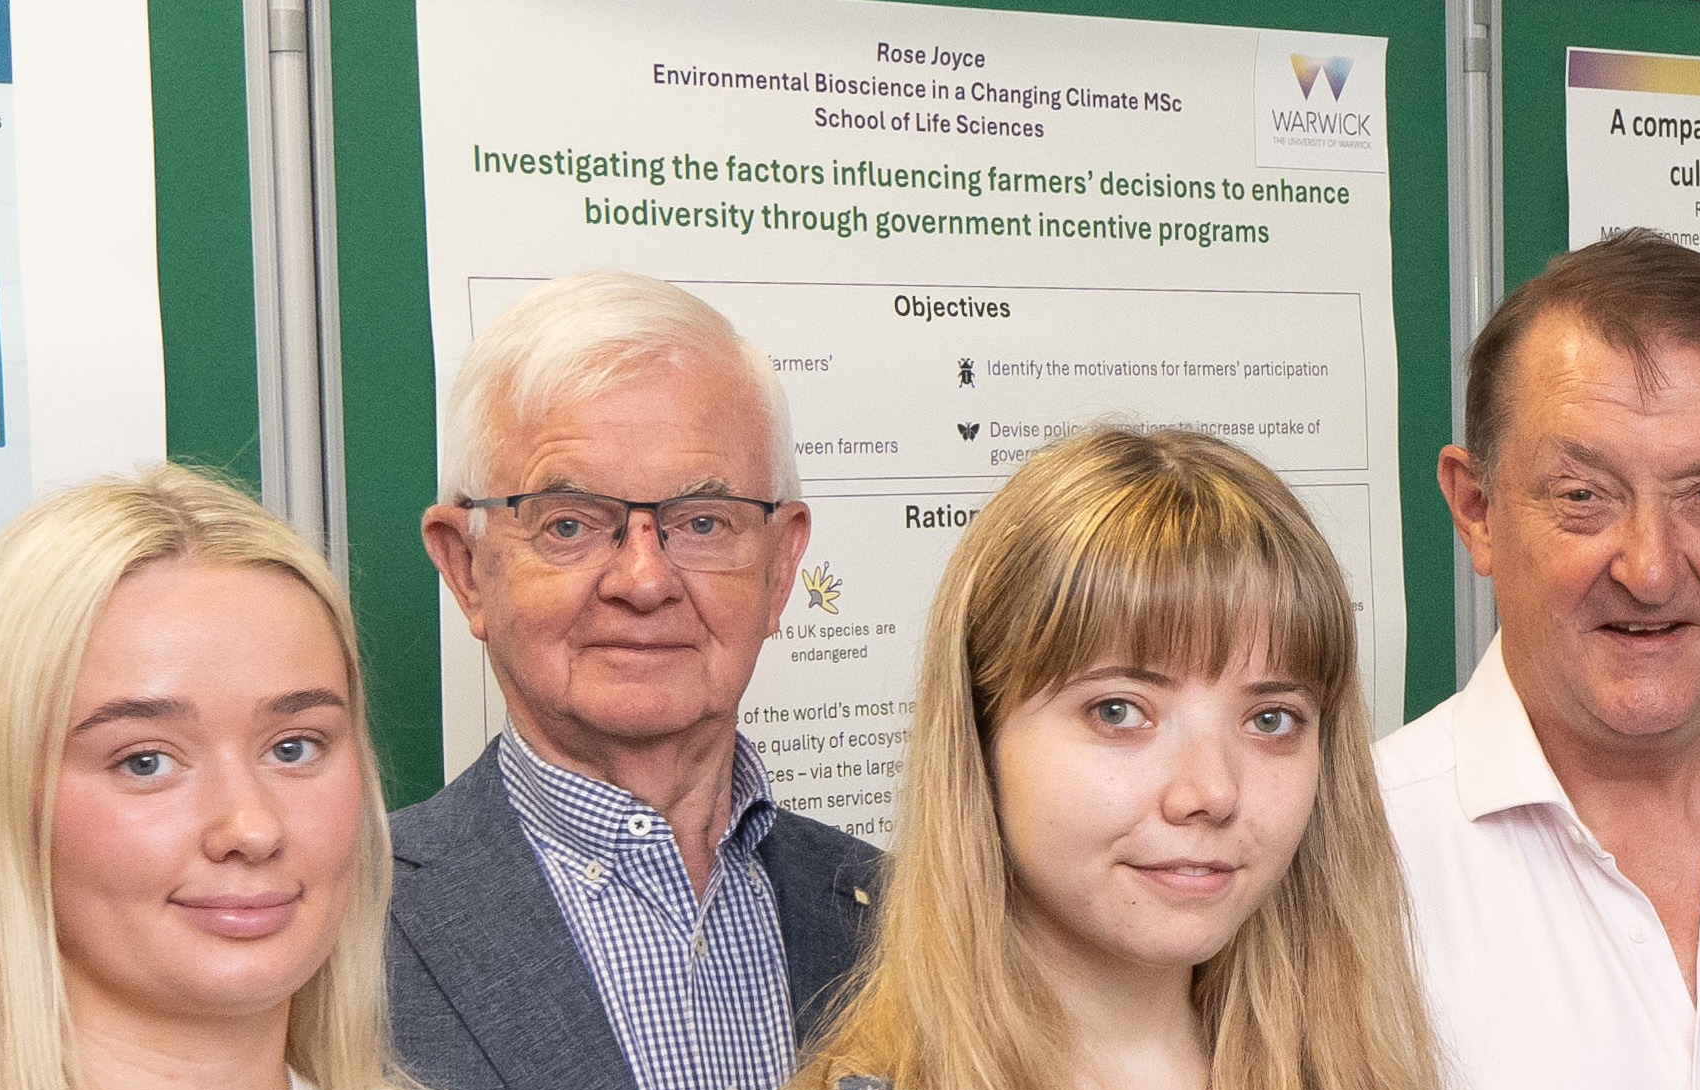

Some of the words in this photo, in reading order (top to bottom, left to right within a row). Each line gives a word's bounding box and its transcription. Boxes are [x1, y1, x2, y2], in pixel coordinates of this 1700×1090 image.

[877, 42, 926, 64] Rose
[931, 46, 985, 71] Joyce
[654, 64, 809, 92] Environmental
[815, 73, 926, 98] Bioscience
[932, 79, 949, 99] in
[955, 86, 965, 100] a
[971, 82, 1061, 110] Changing
[1066, 87, 1138, 110] Climate
[1144, 92, 1182, 112] MSc
[815, 107, 886, 130] School
[891, 112, 910, 131] of
[916, 112, 951, 133] Life
[956, 114, 1044, 138] Sciences
[1272, 109, 1371, 136] WARWICK
[1610, 108, 1626, 135] A
[474, 145, 665, 186] Investigating
[672, 153, 718, 181] the
[726, 155, 824, 185] factors
[833, 159, 982, 197] influencing
[988, 166, 1093, 194] farmers’
[1100, 171, 1216, 199] decisions
[1222, 178, 1245, 200] to
[1252, 178, 1349, 205] enhance
[585, 197, 755, 235] biodiversity
[761, 203, 867, 238] through
[876, 211, 1031, 239] government
[1039, 212, 1151, 240] incentive
[1159, 222, 1269, 248] programs
[894, 295, 1010, 322] Objectives
[988, 360, 1043, 380] Identify
[1046, 360, 1069, 376] the
[1074, 360, 1157, 376] motivations
[1161, 360, 1180, 376] for
[1183, 360, 1240, 376] farmers’
[1244, 361, 1328, 379] participation
[791, 645, 867, 663] endangered
